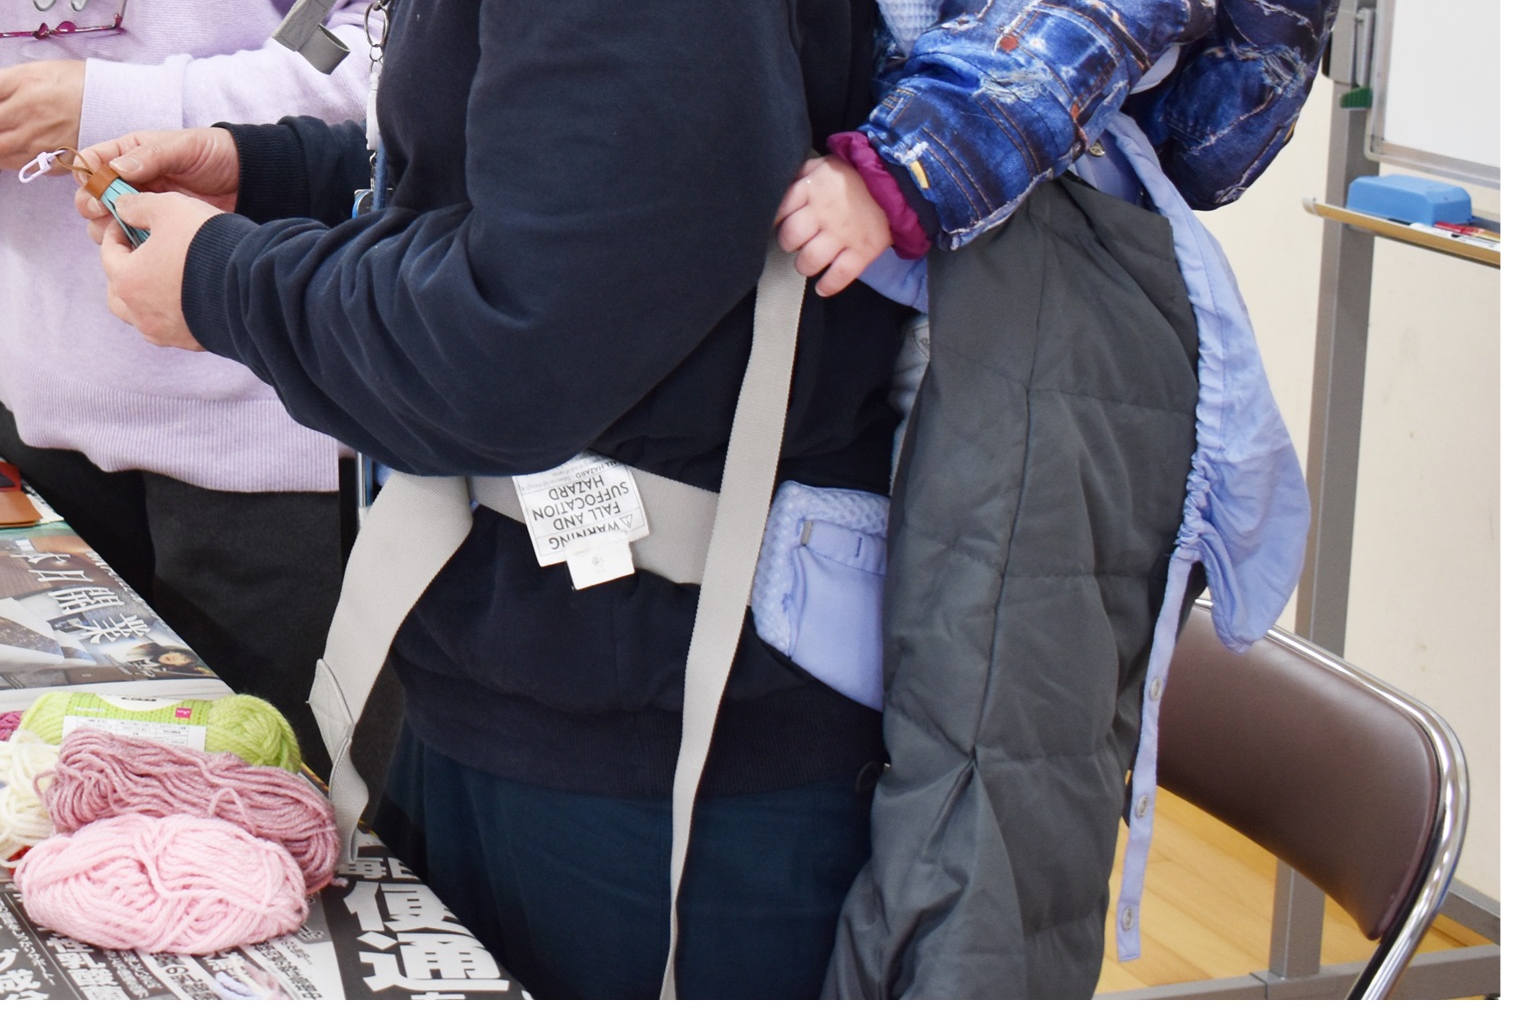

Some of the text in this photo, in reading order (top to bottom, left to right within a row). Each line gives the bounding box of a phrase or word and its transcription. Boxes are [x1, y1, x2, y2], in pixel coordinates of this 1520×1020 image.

[532, 481, 629, 521] SUFFOCATION
[548, 474, 605, 500] HAZARD
[553, 501, 621, 531] FALL AND
[343, 881, 510, 999] 便通
